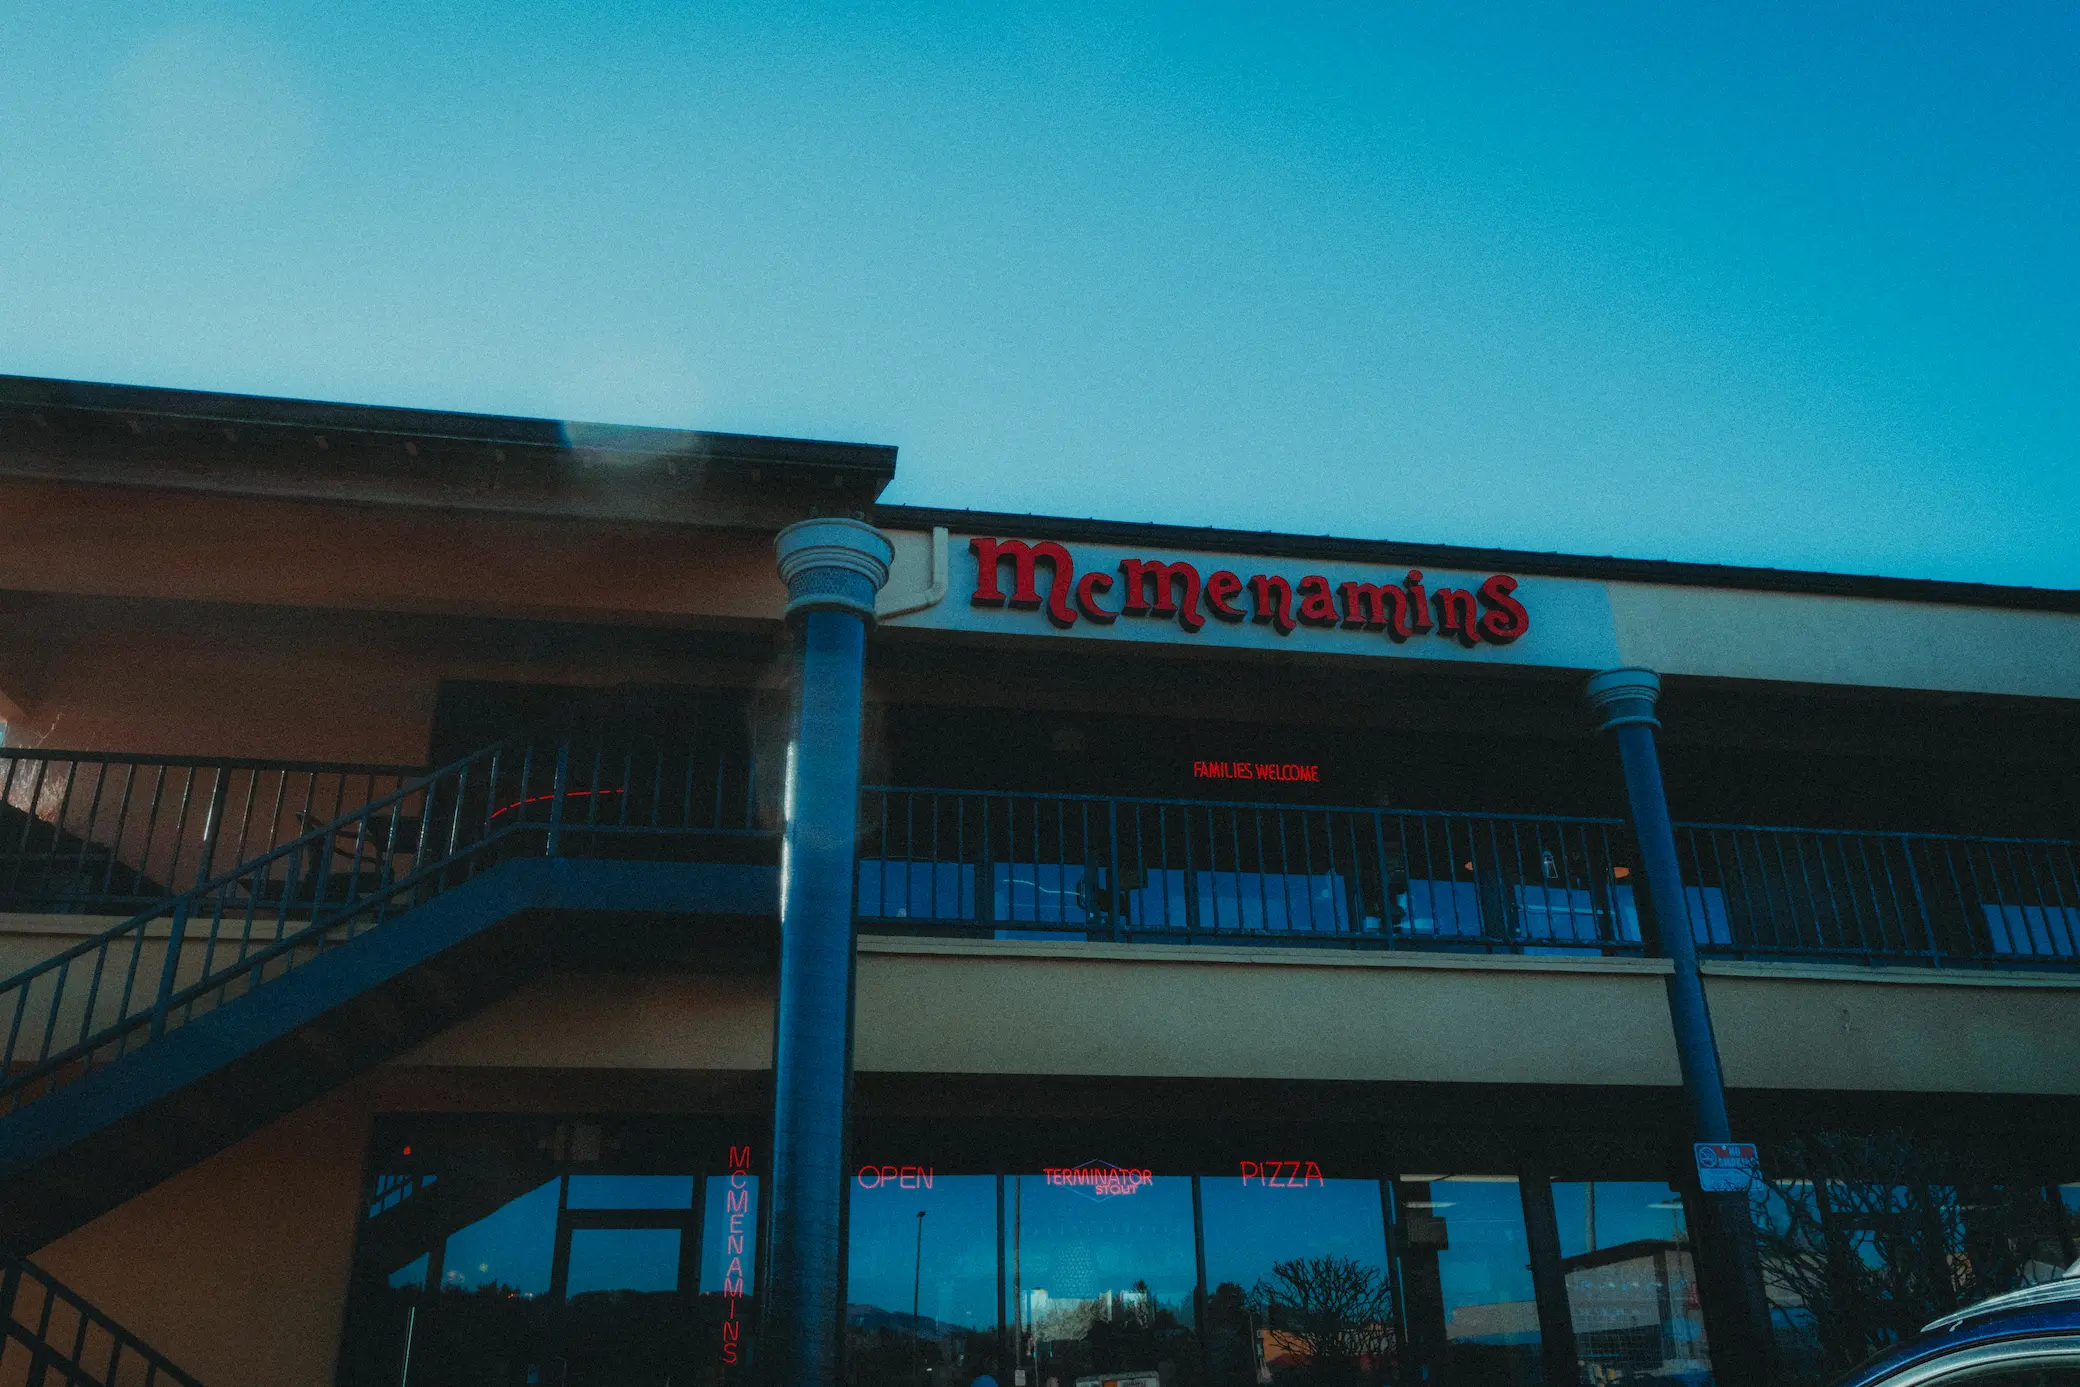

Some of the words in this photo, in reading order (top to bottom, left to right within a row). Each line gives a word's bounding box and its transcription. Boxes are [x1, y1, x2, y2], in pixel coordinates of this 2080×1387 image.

[1193, 761, 1253, 780] FAMILIES
[1254, 763, 1319, 783] WELCOME
[858, 1165, 934, 1190] OPEN
[1043, 1167, 1153, 1186] TERMINATOR
[1240, 1160, 1324, 1188] PIZZA
[1096, 1185, 1138, 1196] STOUT
[723, 1146, 750, 1364] MCMENAMINS
